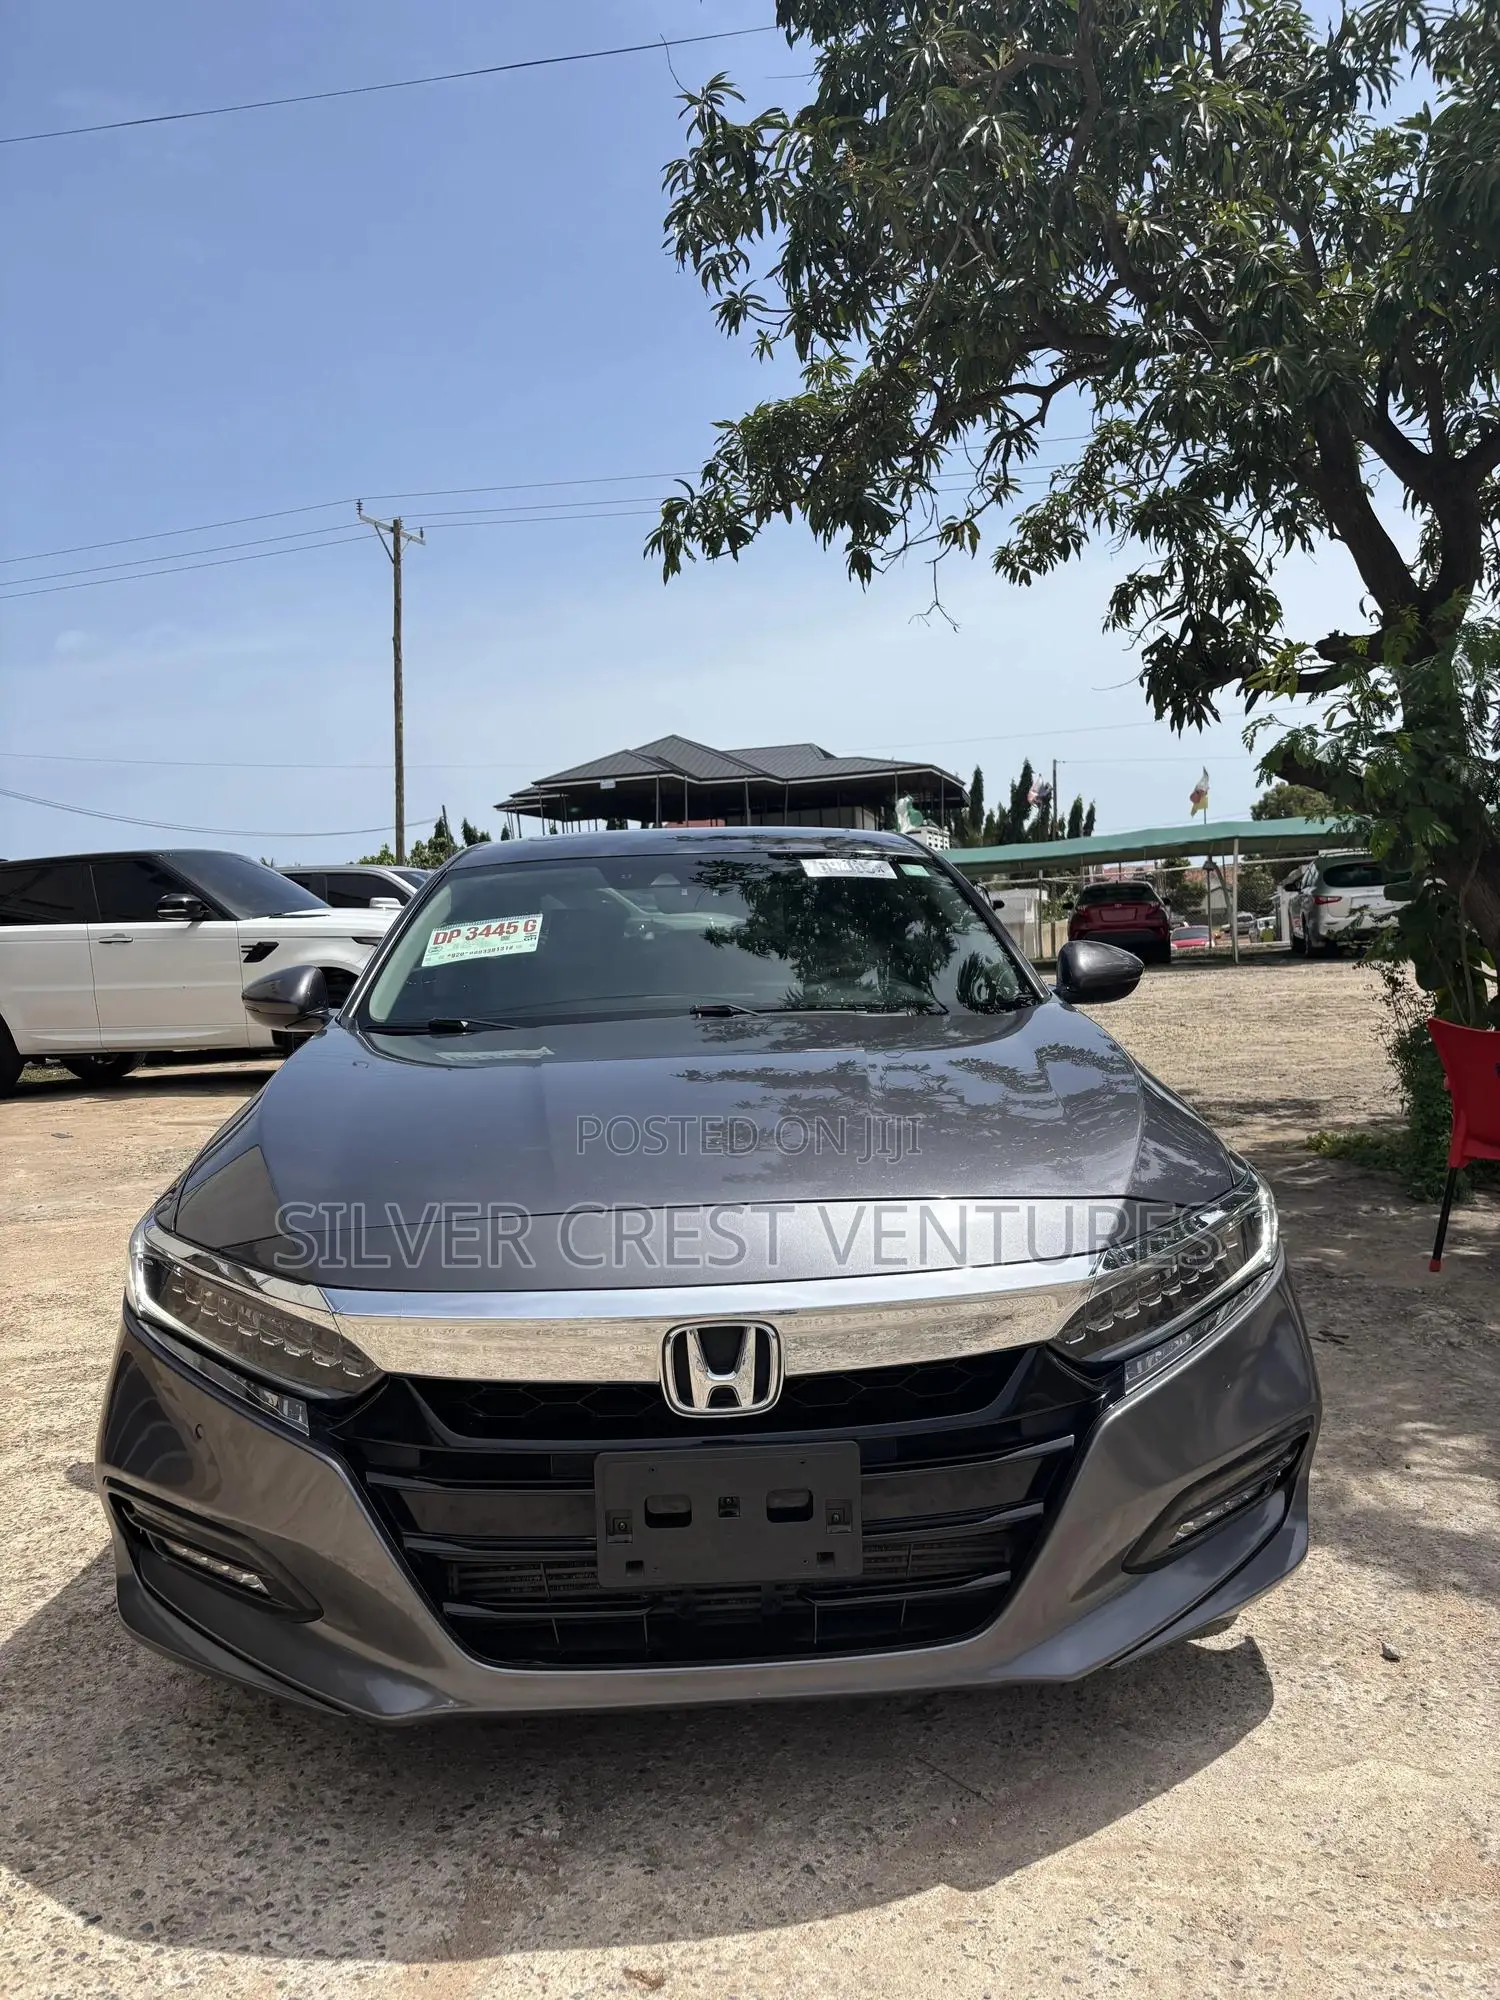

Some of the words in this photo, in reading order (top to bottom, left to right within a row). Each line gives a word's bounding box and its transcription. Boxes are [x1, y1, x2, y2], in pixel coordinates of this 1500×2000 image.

[433, 928, 461, 945] DP
[465, 920, 519, 941] 3445
[523, 919, 537, 933] G
